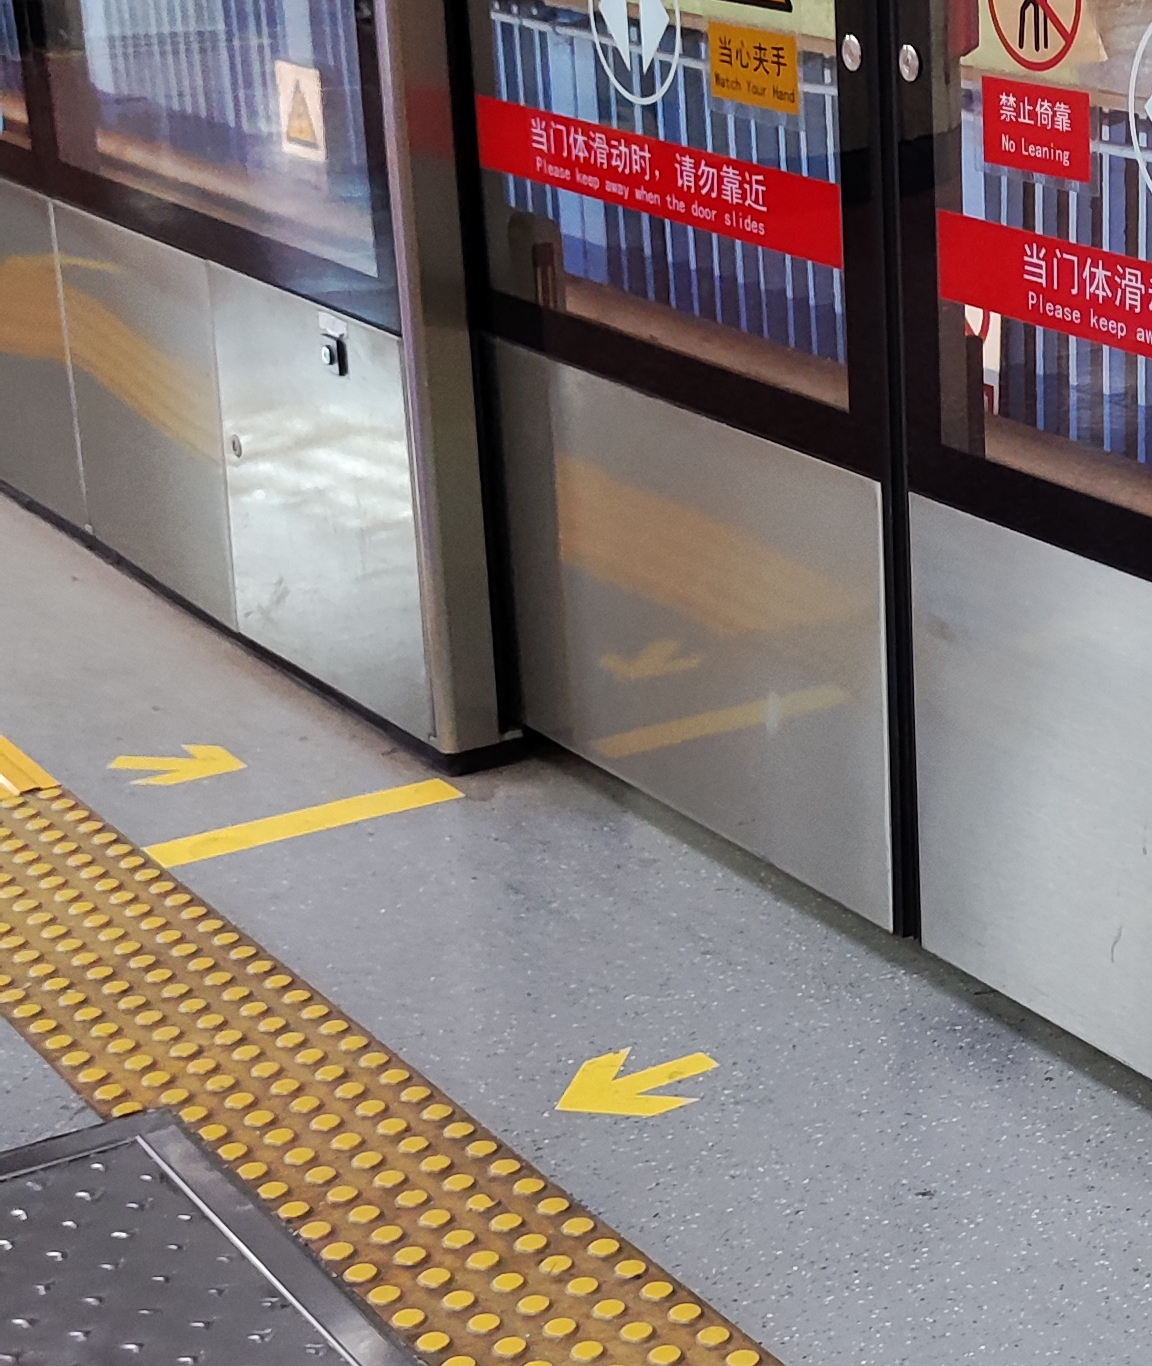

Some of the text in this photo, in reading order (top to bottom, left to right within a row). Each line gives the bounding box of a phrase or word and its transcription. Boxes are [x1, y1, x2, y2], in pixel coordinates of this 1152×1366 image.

[718, 36, 787, 77] 当心夹手
[714, 71, 795, 103] Watch Your Hand
[999, 91, 1071, 132] 禁止倚靠
[1001, 133, 1071, 167] No Leaning
[536, 156, 765, 236] Please keep away when the door slides
[1028, 291, 1081, 324] Please
[1090, 308, 1127, 340] keep
